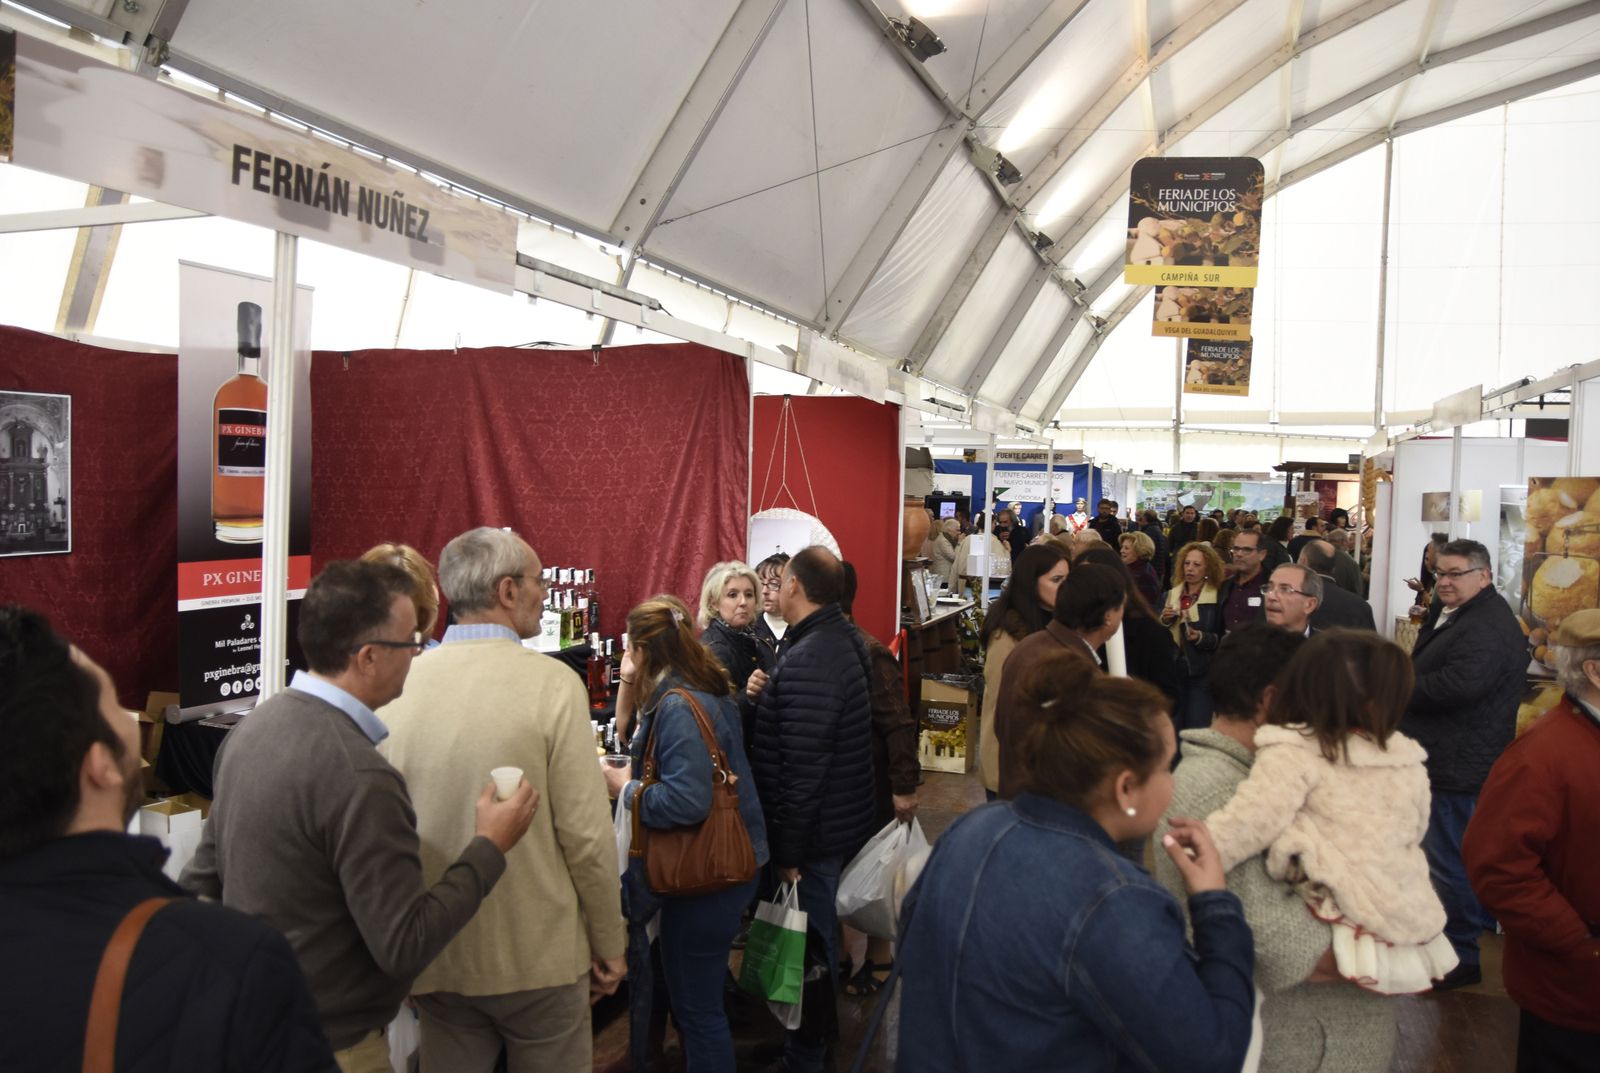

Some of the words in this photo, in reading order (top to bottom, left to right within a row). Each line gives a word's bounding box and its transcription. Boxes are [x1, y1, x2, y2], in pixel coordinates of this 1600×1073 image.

[232, 144, 349, 217] FERNÁN
[357, 186, 430, 243] NUÑEZ
[1158, 188, 1193, 200] FERIA
[1194, 188, 1210, 200] DE
[1213, 188, 1236, 201] LOS
[1157, 200, 1237, 213] MUNICIPIOS
[1161, 272, 1199, 281] CAMPIÑA
[1203, 273, 1220, 282] SUR
[1164, 326, 1180, 334] VEGA
[1192, 328, 1238, 336] GUADALQUIVIR
[1021, 472, 1065, 480] CARRETOS
[203, 573, 223, 586] PX
[215, 640, 226, 648] Mil
[227, 637, 257, 647] Paladares
